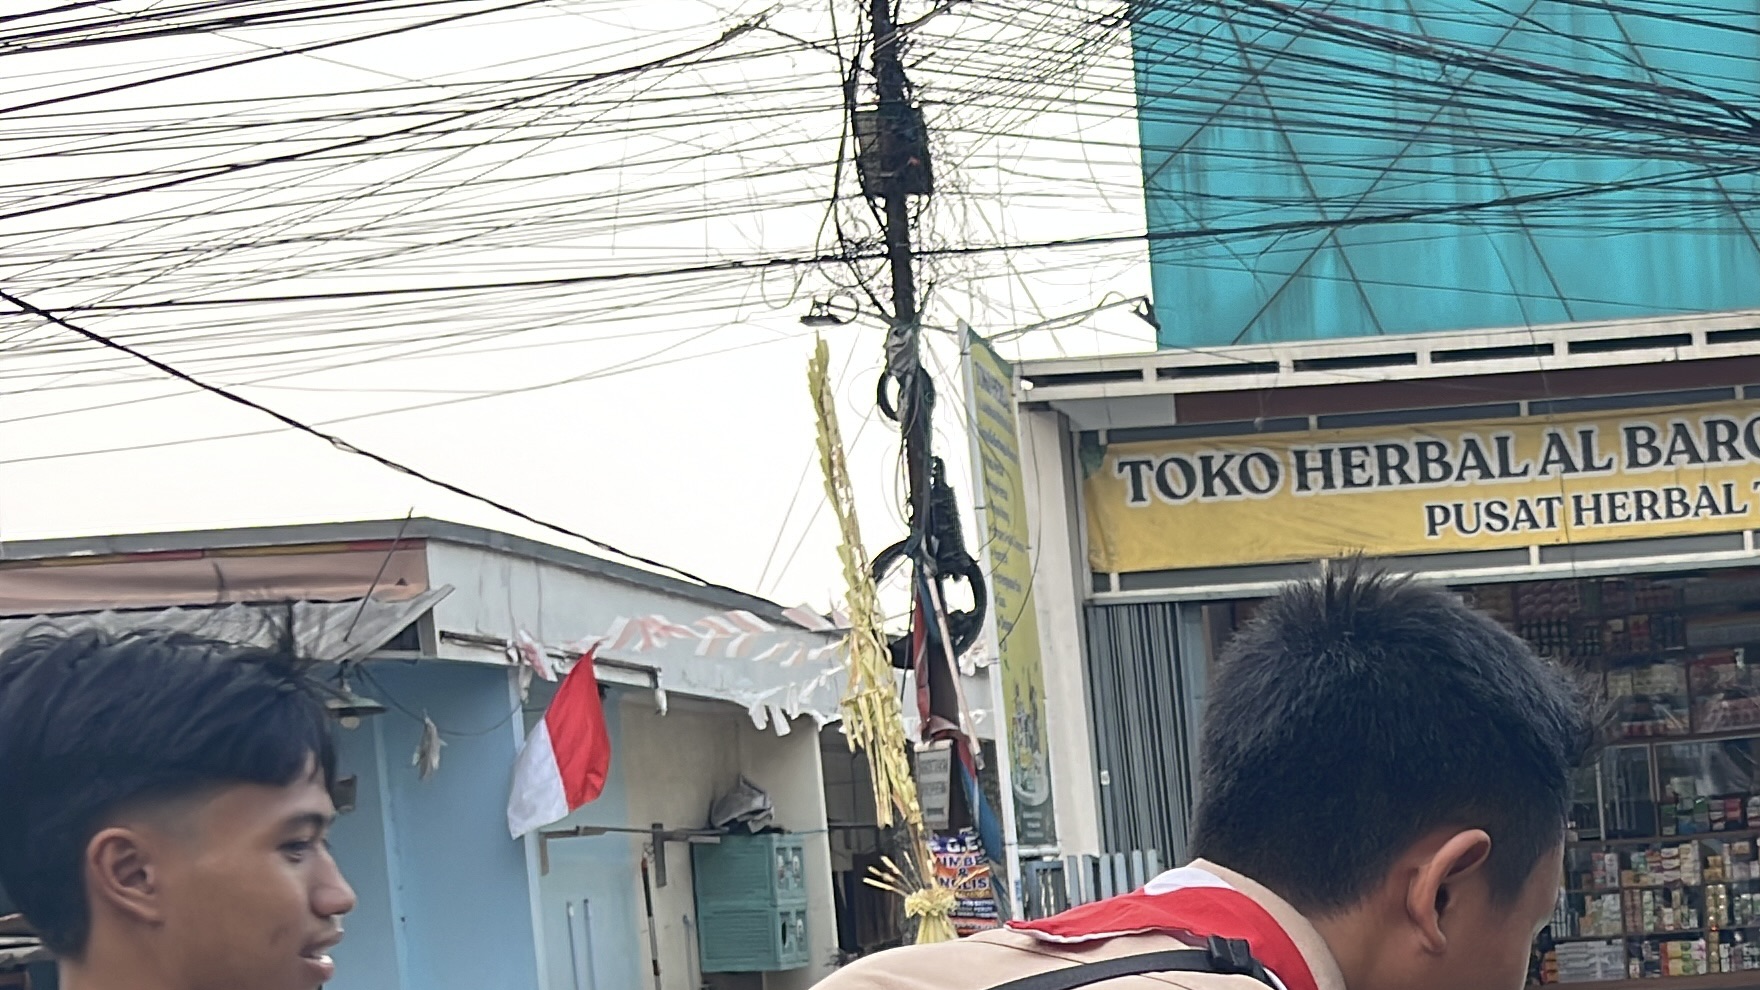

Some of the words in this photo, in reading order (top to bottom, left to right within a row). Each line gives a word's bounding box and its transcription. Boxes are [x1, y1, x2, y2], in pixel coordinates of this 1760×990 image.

[1117, 451, 1279, 502] TOKO
[1292, 436, 1528, 491] HERBAL
[1538, 429, 1613, 477] AL
[1425, 496, 1562, 537] PUSAT
[1573, 484, 1747, 526] HERBAL
